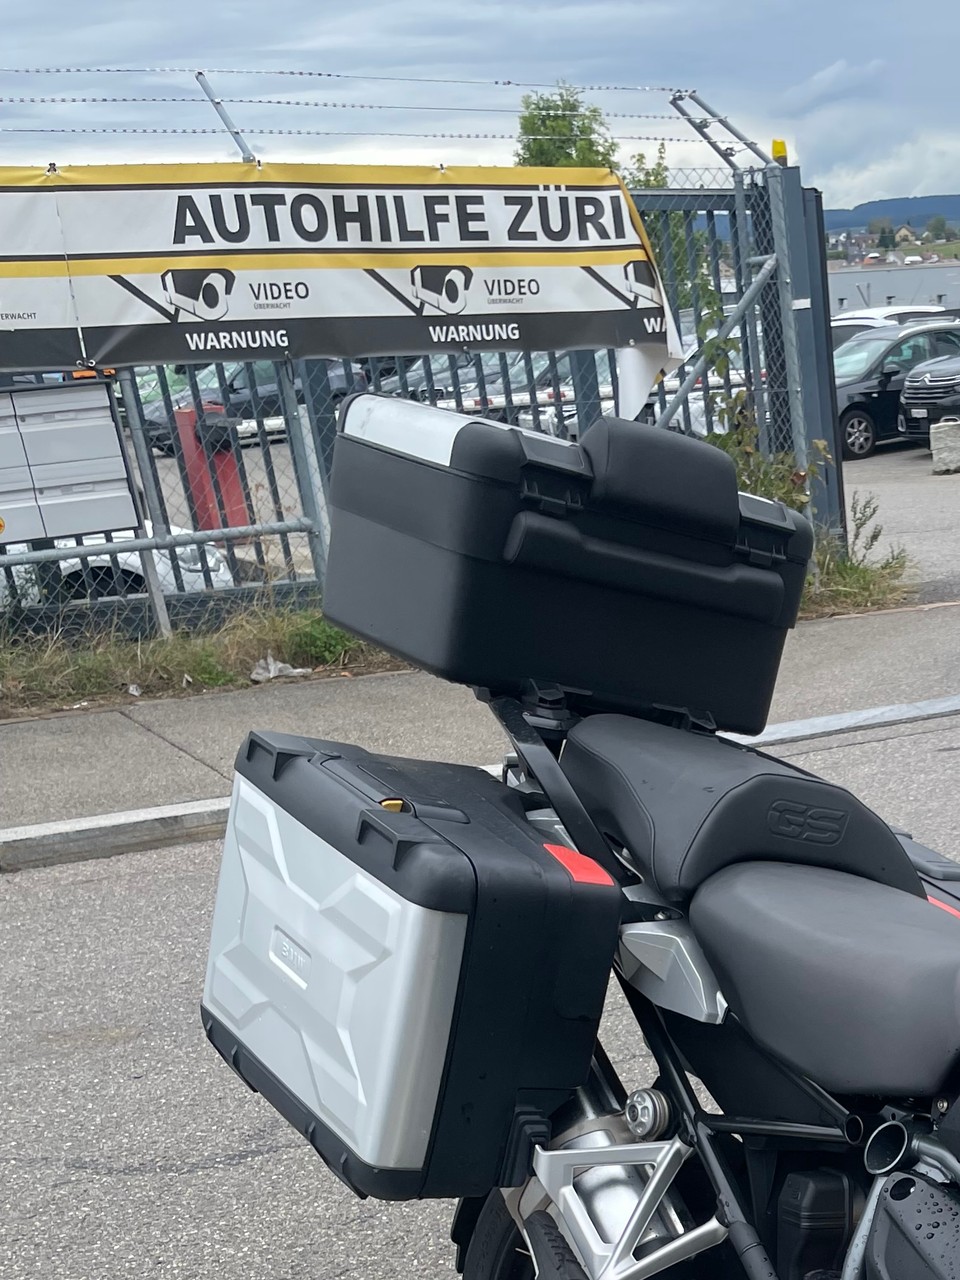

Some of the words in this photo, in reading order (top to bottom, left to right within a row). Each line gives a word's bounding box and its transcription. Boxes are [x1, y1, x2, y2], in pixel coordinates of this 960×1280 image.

[172, 193, 489, 244] AUTOHILFE
[503, 184, 627, 242] ZÜRI
[248, 281, 310, 301] VIDEO
[483, 278, 541, 296] VIDEO
[0, 312, 37, 321] ERWACHT
[185, 329, 289, 351] WARNUNG
[428, 323, 520, 343] WARNUNG
[768, 799, 847, 845] GS
